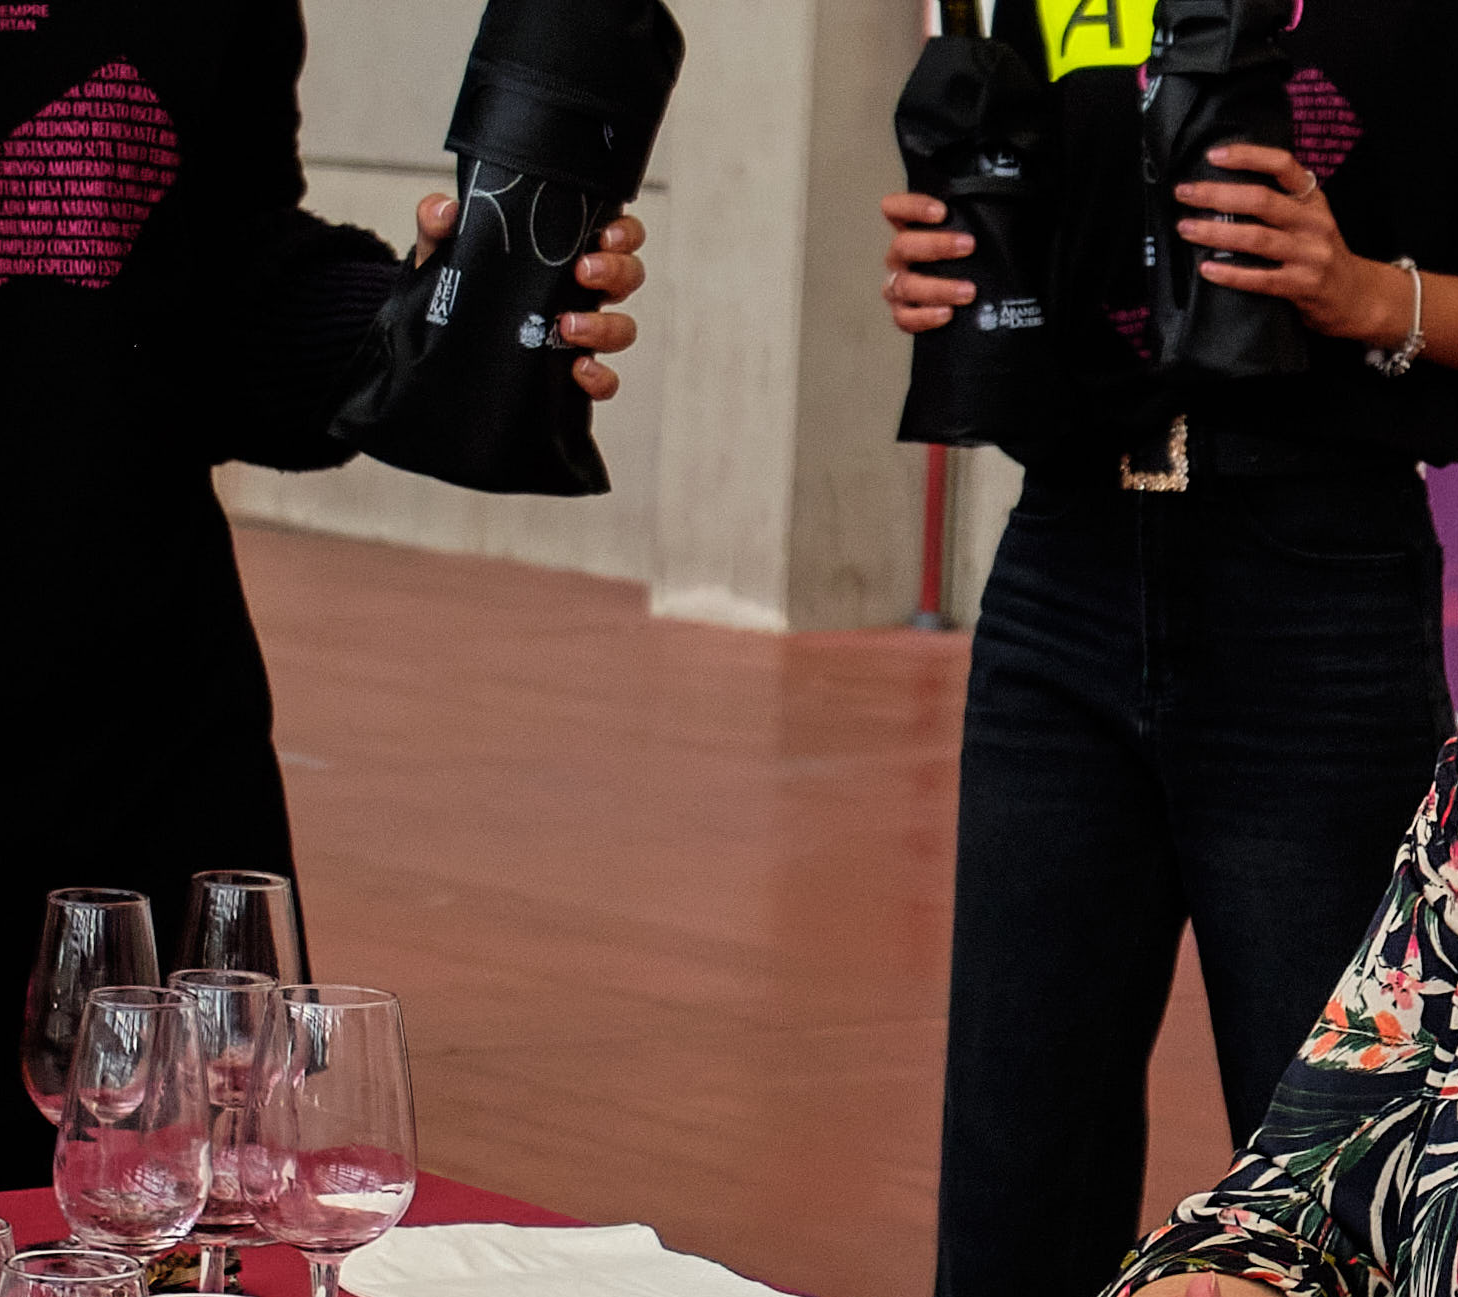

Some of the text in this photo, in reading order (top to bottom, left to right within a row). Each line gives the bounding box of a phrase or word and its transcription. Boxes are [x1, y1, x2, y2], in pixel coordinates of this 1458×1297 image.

[35, 120, 91, 138] REDONDO
[28, 179, 63, 197] FRESA
[28, 200, 60, 216] MORA
[61, 200, 110, 218] NARANJA
[37, 259, 97, 276] ESPECIADO
